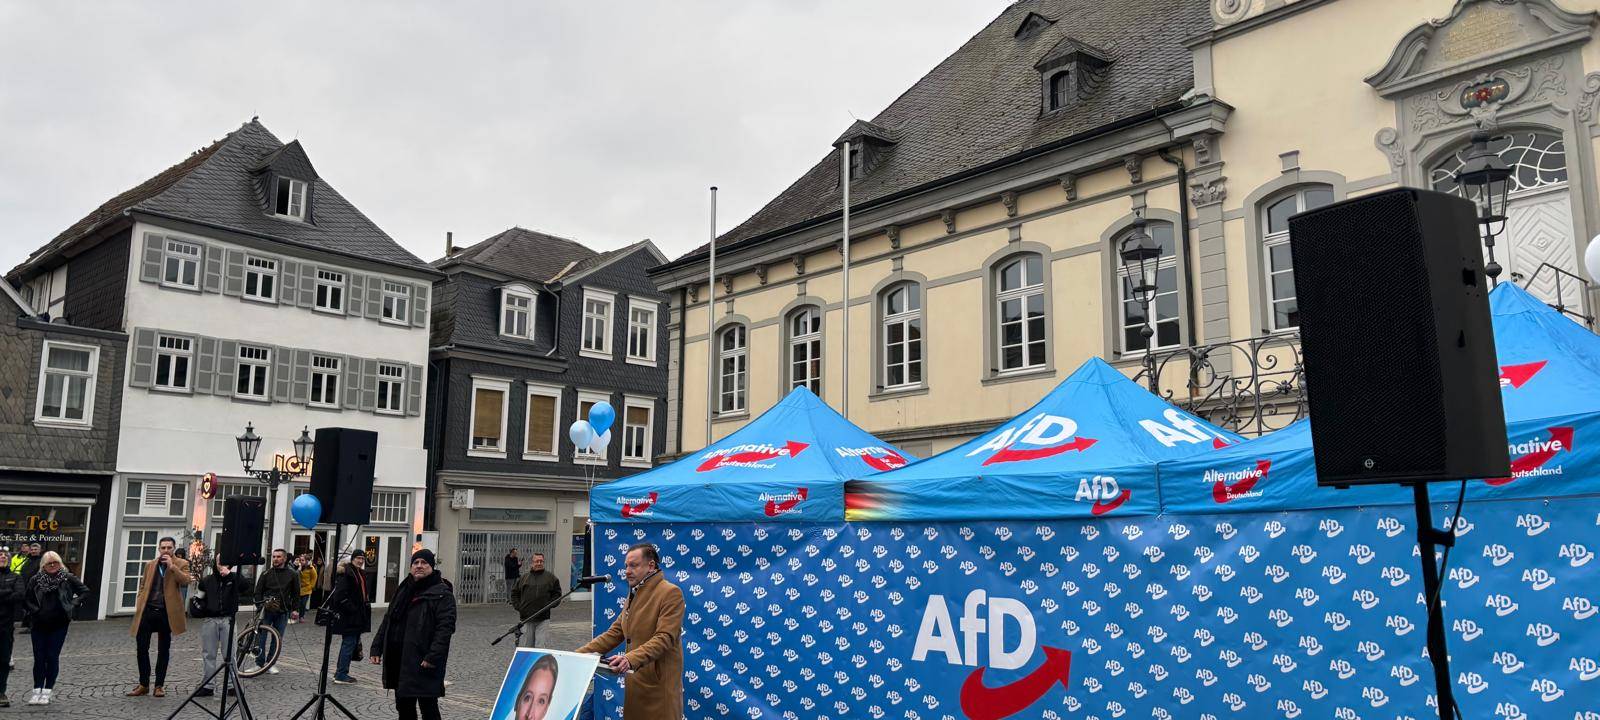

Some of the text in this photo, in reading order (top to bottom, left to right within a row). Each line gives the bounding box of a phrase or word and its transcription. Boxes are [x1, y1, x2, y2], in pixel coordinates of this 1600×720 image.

[1138, 408, 1231, 447] Af
[965, 412, 1078, 457] AfD
[1508, 437, 1562, 455] native
[714, 460, 776, 469] Deutschland
[1202, 467, 1263, 483] Alternative
[1511, 465, 1562, 479] eutschland
[1074, 475, 1120, 502] AfD
[758, 491, 803, 502] Alternative
[1226, 489, 1264, 500] Deutschland
[616, 496, 654, 505] Alternative
[26, 515, 59, 531] Tee
[1264, 520, 1281, 532] AfD
[1319, 520, 1338, 532] AfD
[1377, 517, 1398, 530] AfD
[1516, 515, 1541, 528] AfD
[633, 529, 643, 537] AfD
[691, 529, 701, 537] AfD
[788, 529, 800, 537] AfD
[857, 528, 869, 537] AfD
[995, 527, 1008, 537] AfD
[1036, 526, 1051, 536] AfD
[1081, 525, 1096, 536] AfD
[1120, 525, 1138, 535] AfD
[1168, 524, 1185, 535] AfD
[1216, 521, 1232, 534] AfD
[39, 534, 73, 542] Porzellan
[738, 545, 749, 553] AfD
[839, 545, 851, 554] AfD
[940, 545, 954, 555] AfD
[1017, 546, 1031, 556] AfD
[1060, 546, 1075, 557] AfD
[1103, 546, 1116, 557] AfD
[1143, 546, 1160, 557] AfD
[1194, 546, 1209, 558] AfD
[1239, 545, 1255, 557] AfD
[1292, 544, 1311, 557] AfD
[1349, 544, 1369, 558] AfD
[1483, 544, 1506, 558] AfD
[1559, 544, 1585, 559] AfD
[604, 555, 614, 563] AfD
[692, 557, 702, 565] AfD
[788, 557, 799, 567] AfD
[855, 559, 867, 568] AfD
[960, 561, 973, 571] AfD
[1000, 562, 1013, 572] AfD
[1040, 562, 1055, 572] AfD
[1082, 563, 1096, 573] AfD
[1123, 563, 1137, 574] AfD
[1170, 564, 1186, 575] AfD
[1215, 564, 1231, 576] AfD
[1265, 565, 1283, 577] AfD
[1322, 565, 1340, 577] AfD
[739, 572, 750, 580] AfD
[803, 574, 815, 582] AfD
[1381, 567, 1403, 579] AfD
[1449, 567, 1472, 581] AfD
[1522, 568, 1547, 583] AfD
[905, 576, 918, 586] AfD
[1061, 581, 1076, 591] AfD
[689, 584, 701, 592] AfD
[785, 588, 797, 596] AfD
[1104, 582, 1117, 593] AfD
[1146, 583, 1163, 594] AfD
[1192, 585, 1207, 596] AfD
[1240, 586, 1258, 598] AfD
[854, 590, 866, 599] AfD
[1296, 588, 1313, 600] AfD
[1352, 589, 1372, 602] AfD
[704, 601, 714, 609] AfD
[1041, 598, 1055, 609] AfD
[1082, 600, 1097, 611] AfD
[1485, 594, 1509, 608] AfD
[1563, 597, 1589, 612] AfD
[802, 605, 814, 614] AfD
[870, 609, 882, 618] AfD
[1125, 602, 1139, 614] AfD
[1170, 604, 1185, 615] AfD
[1217, 607, 1233, 618] AfD
[751, 616, 762, 624] AfD
[1269, 609, 1287, 621] AfD
[1325, 612, 1344, 624] AfD
[819, 620, 830, 628] AfD
[1061, 620, 1076, 630] AfD
[1386, 615, 1407, 629] AfD
[1453, 620, 1475, 634] AfD
[887, 624, 900, 634] AfD
[911, 589, 1036, 670] AfD
[1104, 623, 1119, 635] AfD
[1148, 626, 1163, 637] AfD
[1194, 628, 1210, 640] AfD
[1526, 623, 1551, 638] AfD
[767, 632, 778, 641] AfD
[836, 636, 847, 646] AfD
[1244, 632, 1262, 645] AfD
[718, 644, 728, 652] AfD
[1082, 638, 1097, 649] AfD
[1127, 642, 1141, 654] AfD
[1299, 636, 1317, 649] AfD
[1357, 641, 1378, 654] AfD
[784, 649, 795, 658] AfD
[1171, 646, 1186, 657] AfD
[1219, 650, 1237, 662] AfD
[851, 655, 864, 664] AfD
[1273, 654, 1291, 667] AfD
[1493, 652, 1516, 666] AfD
[1569, 657, 1596, 672] AfD
[734, 662, 745, 670] AfD
[1105, 660, 1120, 671] AfD
[1149, 664, 1164, 675] AfD
[1330, 659, 1350, 672] AfD
[800, 668, 812, 676] AfD
[1196, 669, 1213, 680] AfD
[1391, 665, 1412, 679] AfD
[716, 674, 728, 682] AfD
[750, 677, 760, 685] AfD
[1083, 678, 1098, 688] AfD
[1248, 674, 1266, 686] AfD
[1458, 672, 1480, 686] AfD
[783, 680, 794, 688] AfD
[1128, 682, 1143, 693] AfD
[1303, 680, 1322, 693] AfD
[1531, 679, 1555, 694] AfD
[731, 689, 744, 698] AfD
[851, 687, 864, 696] AfD
[1173, 688, 1189, 699] AfD
[1362, 687, 1382, 700] AfD
[688, 699, 698, 707] AfD
[923, 695, 936, 705] AfD
[1063, 696, 1077, 707] AfD
[1223, 693, 1241, 705] AfD
[716, 703, 726, 711] AfD
[1106, 700, 1122, 712] AfD
[1277, 699, 1296, 712] AfD
[1494, 702, 1520, 717] AfD
[1335, 706, 1355, 719] AfD
